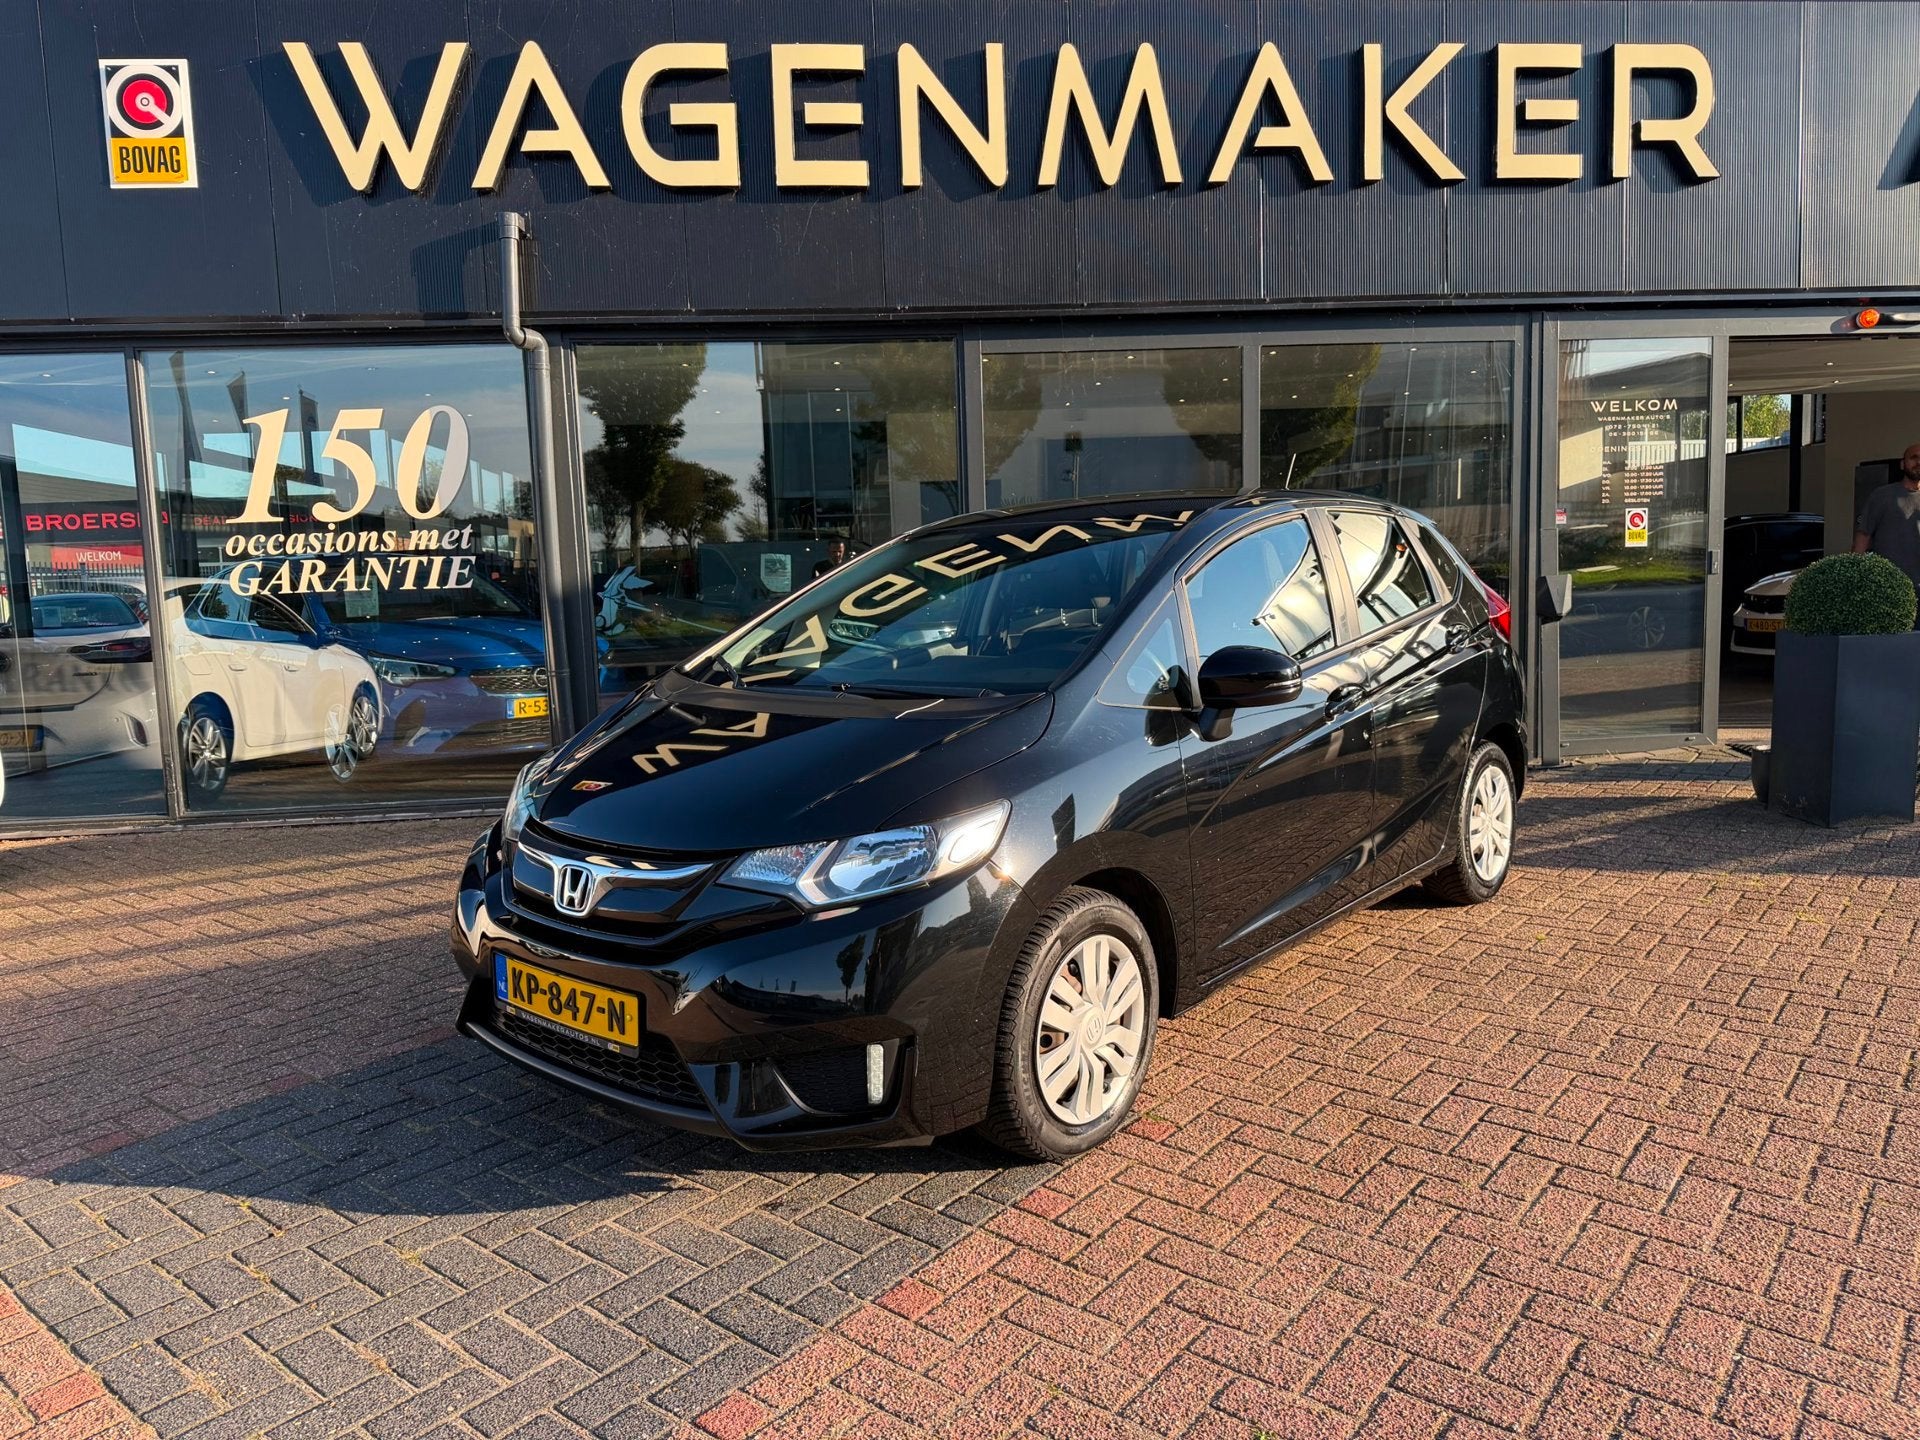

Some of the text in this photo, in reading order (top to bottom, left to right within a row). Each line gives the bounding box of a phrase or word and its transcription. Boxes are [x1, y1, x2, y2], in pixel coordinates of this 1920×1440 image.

[284, 42, 1718, 190] WAGENMAKER
[119, 145, 181, 174] BOVAG
[1590, 399, 1678, 412] WELKOM
[225, 405, 470, 525] 150
[225, 523, 474, 557] occasions met
[1628, 531, 1645, 540] BOVAG
[75, 550, 122, 562] WELKOM
[229, 556, 477, 597] GARANTIE
[511, 966, 626, 1037] KP-847-N
